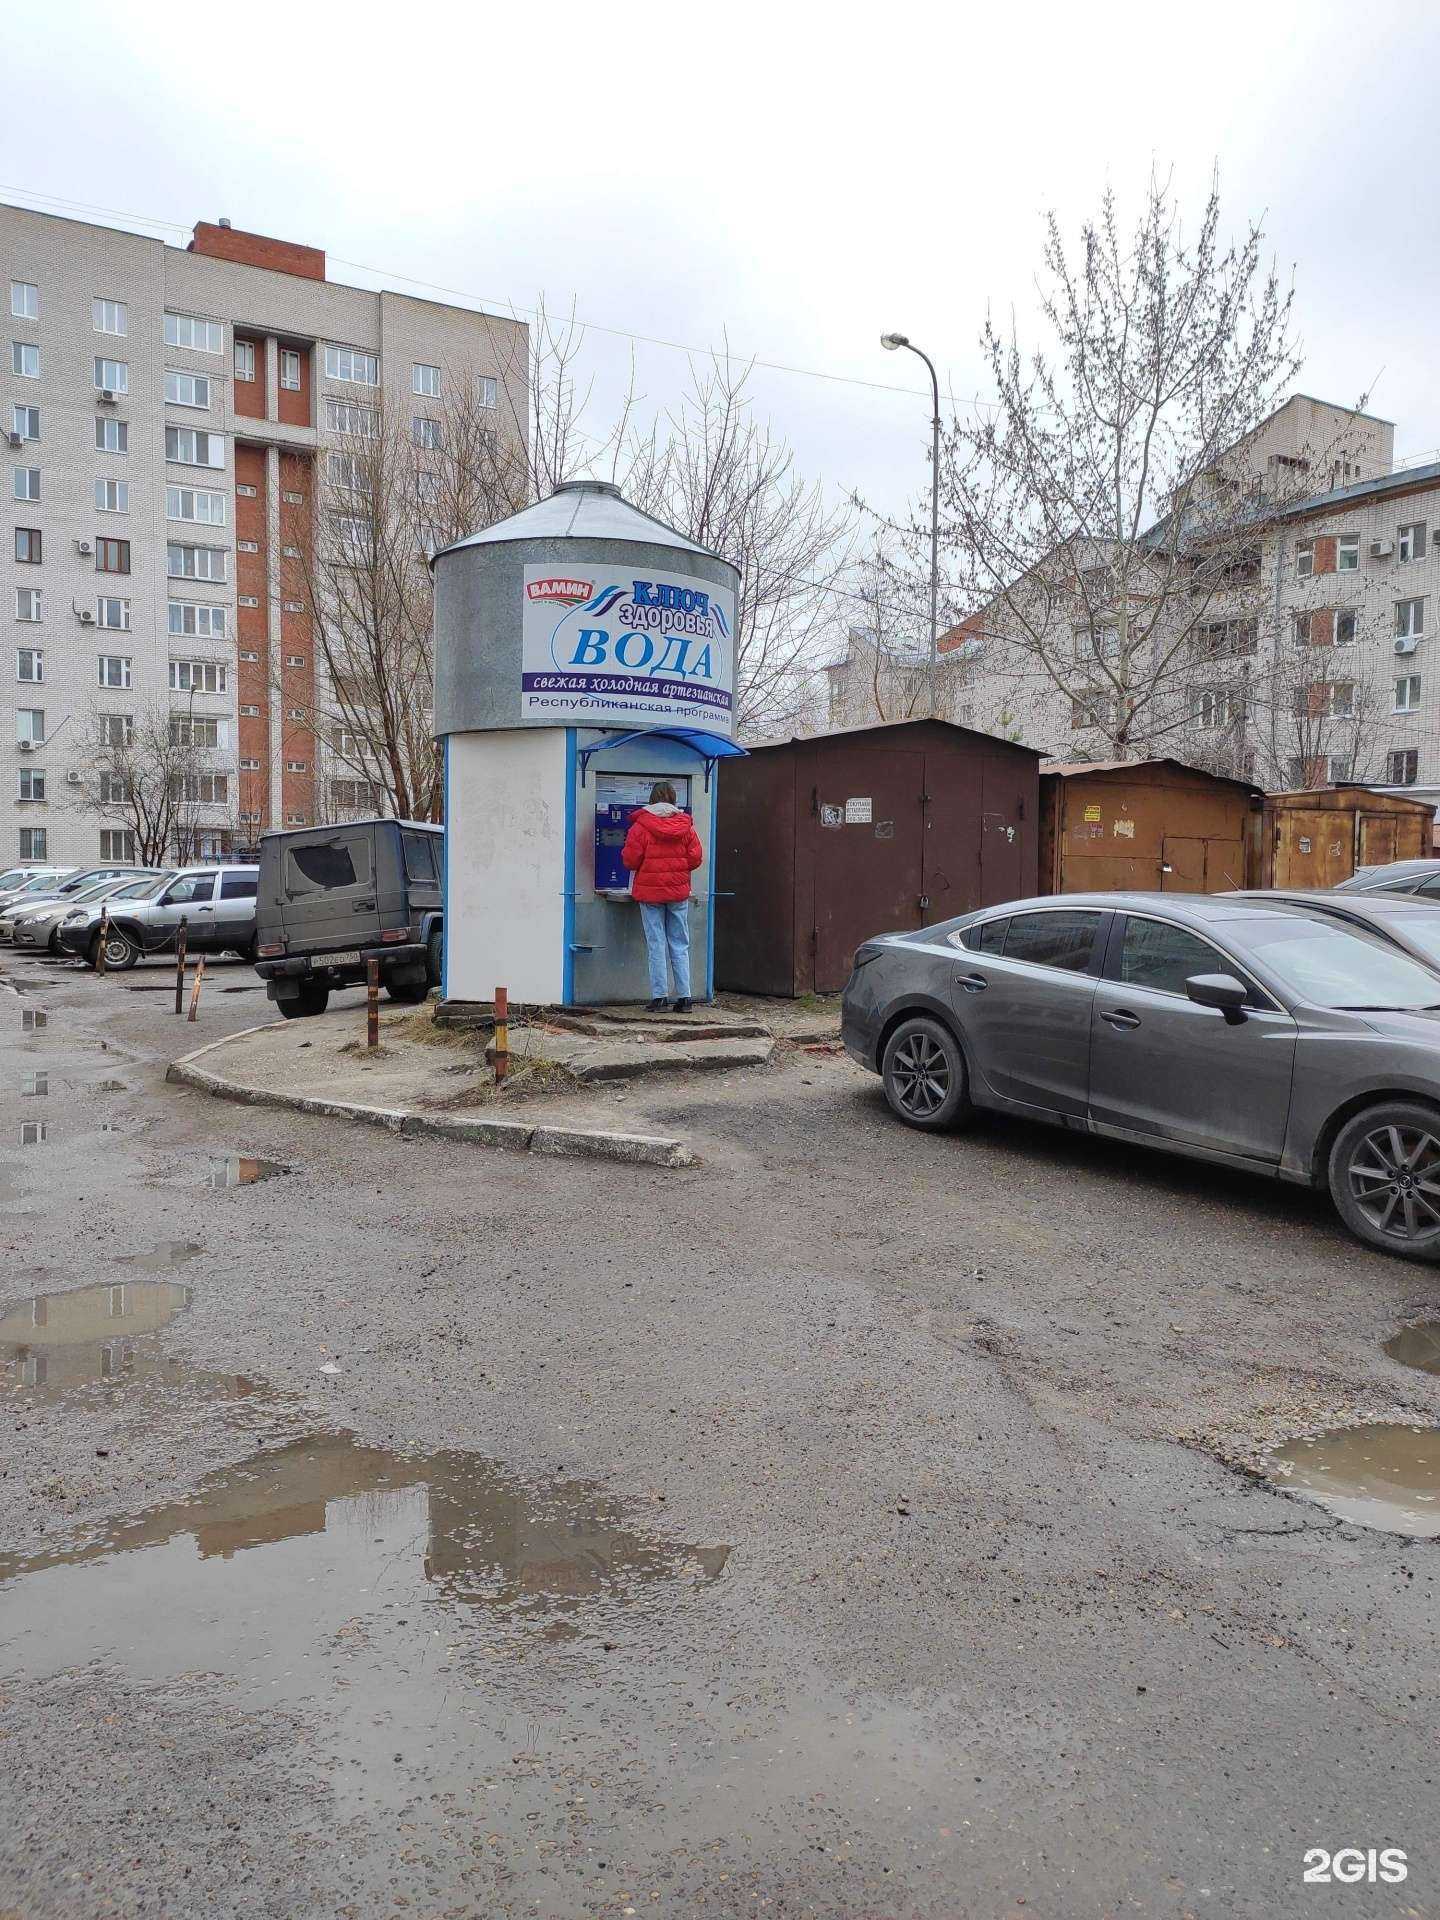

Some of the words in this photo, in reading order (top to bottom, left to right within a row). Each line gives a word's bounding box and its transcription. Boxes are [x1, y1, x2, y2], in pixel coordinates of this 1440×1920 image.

[530, 581, 590, 598] ВАМИН
[632, 580, 710, 617] КЛЮЧ
[568, 628, 713, 681] ВОДА
[529, 696, 672, 714] Республиканская
[533, 675, 587, 689] свежая
[590, 676, 660, 693] холодная
[662, 684, 730, 707] артезианская
